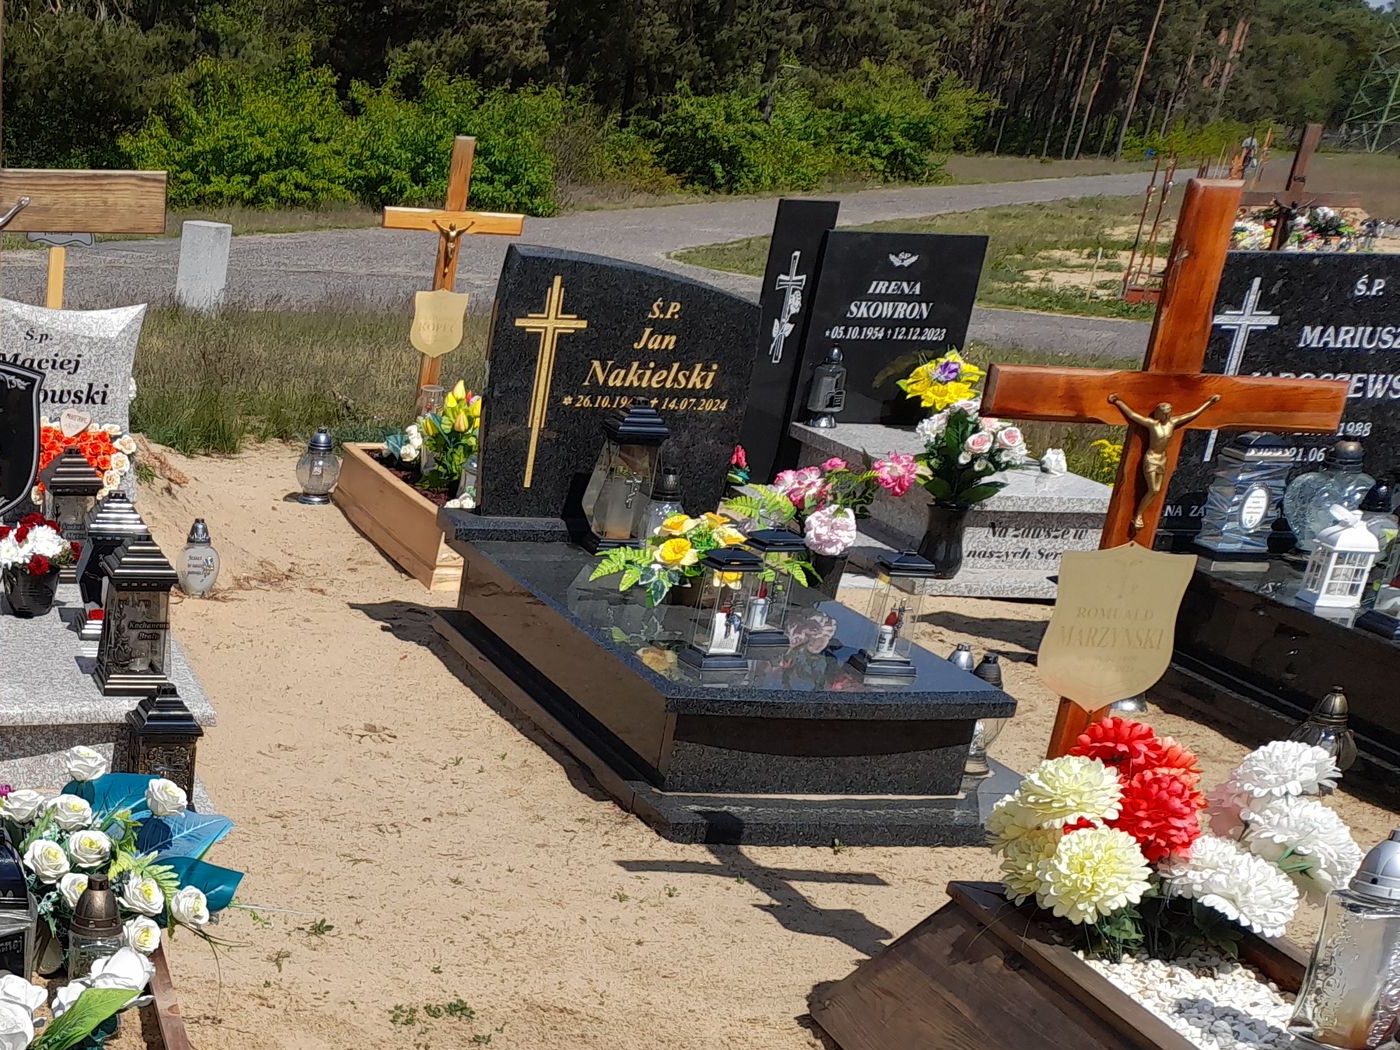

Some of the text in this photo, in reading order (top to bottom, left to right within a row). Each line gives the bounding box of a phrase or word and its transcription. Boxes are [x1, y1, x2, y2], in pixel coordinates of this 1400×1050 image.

[867, 280, 922, 295] IRENA
[1354, 274, 1386, 296] Ś.P.
[648, 298, 682, 319] Ś.P.
[847, 300, 934, 320] SKOWRON
[633, 327, 677, 350] Jan
[830, 326, 947, 341] 05.10.1954 12.12.2023
[1298, 325, 1400, 349] MARIUS
[0, 353, 82, 375] Maciej
[583, 360, 718, 390] Nakielski
[40, 383, 109, 405] owski
[662, 398, 728, 411] 14.07.2024
[1163, 505, 1182, 517] NA
[985, 521, 1088, 540] Na zawsze w
[966, 548, 1031, 562] naszych
